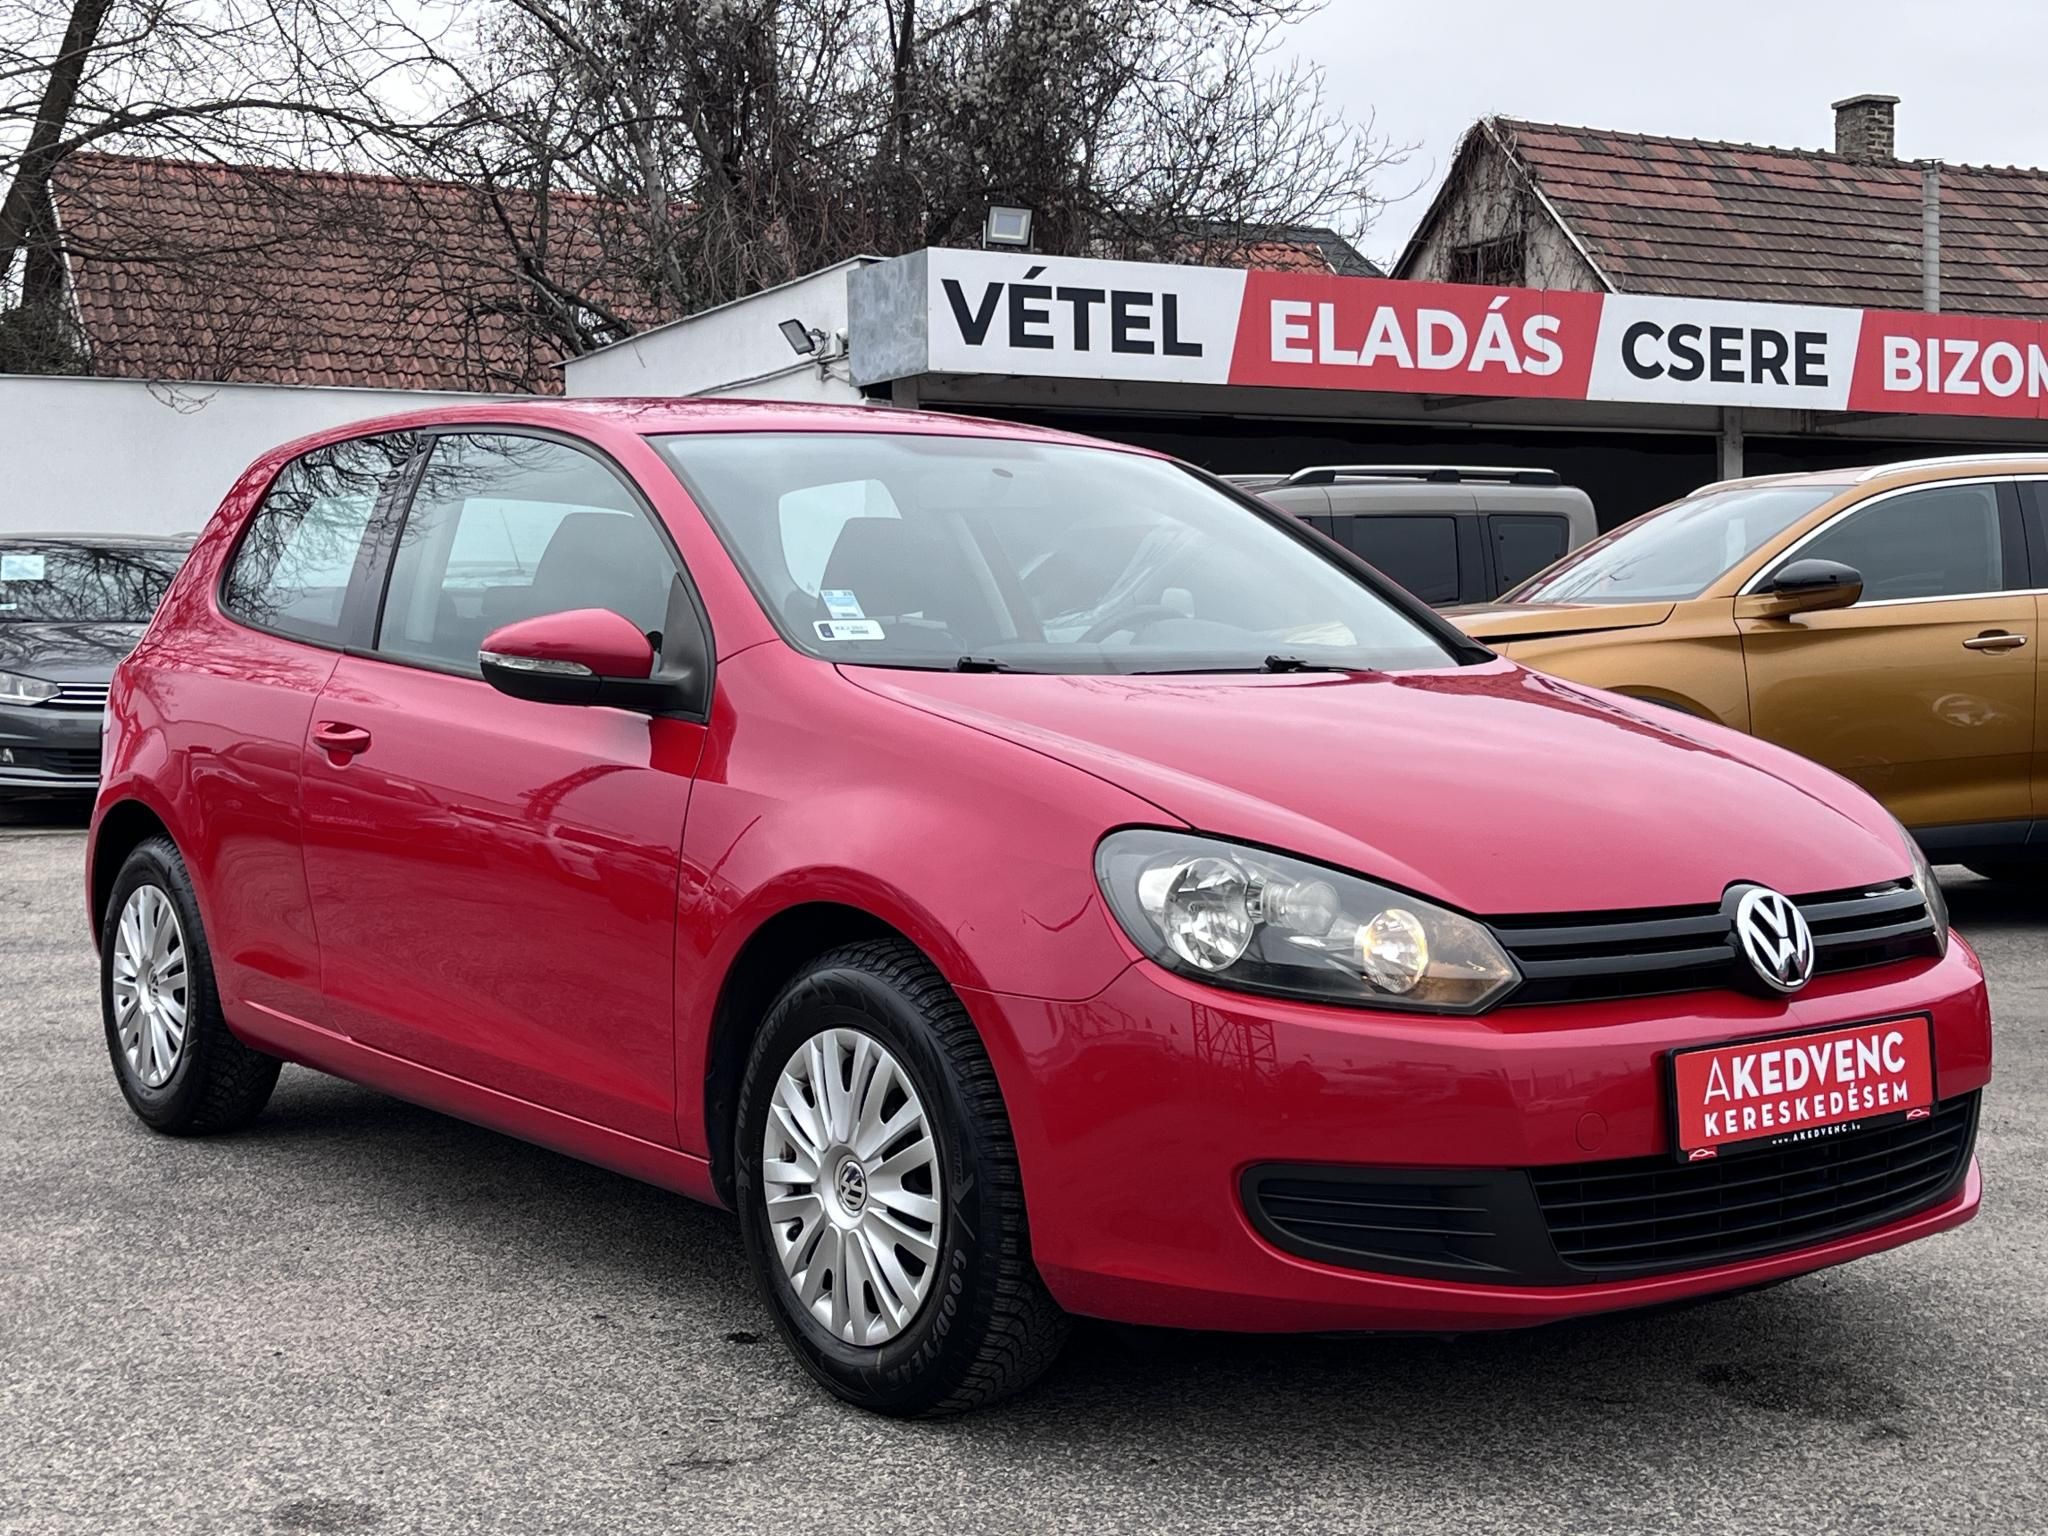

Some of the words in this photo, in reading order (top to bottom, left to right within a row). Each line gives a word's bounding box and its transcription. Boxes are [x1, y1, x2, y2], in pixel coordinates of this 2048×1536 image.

[941, 265, 1203, 358] VÉTEL
[1270, 296, 1564, 377] ELADÁS
[1621, 320, 1829, 387] CSERE
[1704, 1080, 1909, 1138] KERESKEDÉSEM
